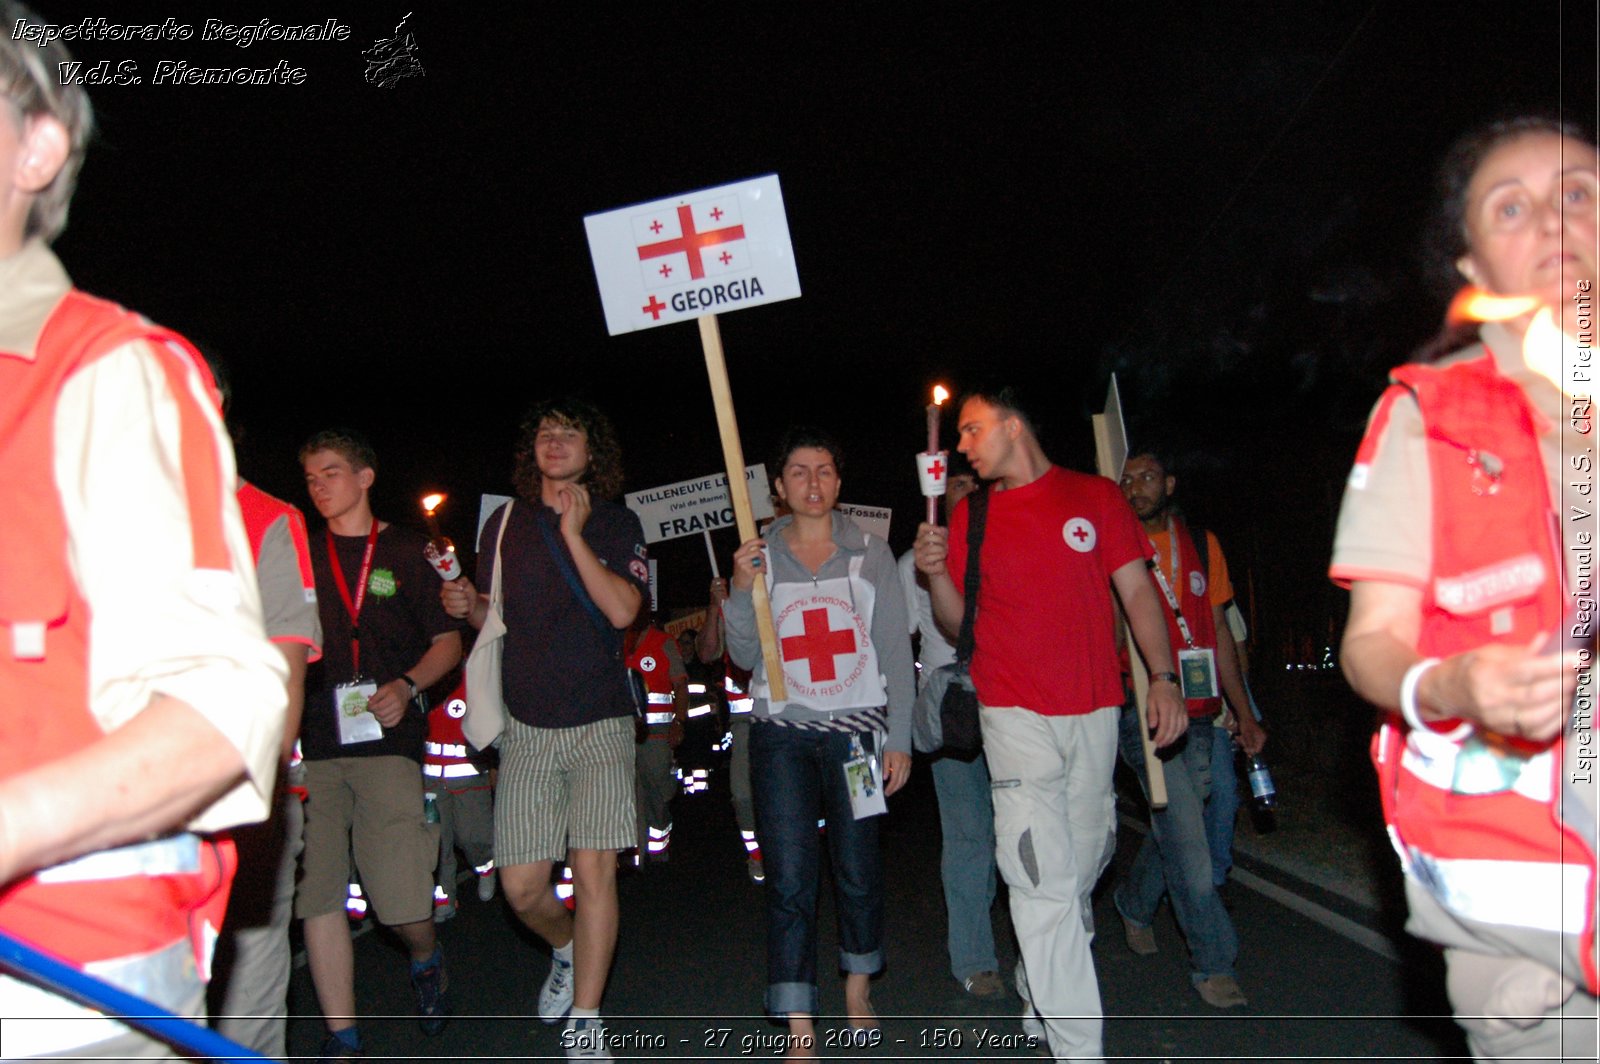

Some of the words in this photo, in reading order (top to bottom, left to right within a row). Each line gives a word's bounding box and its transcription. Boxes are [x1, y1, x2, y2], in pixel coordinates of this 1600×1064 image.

[671, 277, 764, 312] GEORGIA
[637, 480, 712, 505] VILLENEUVE
[670, 502, 686, 511] (Val
[699, 493, 727, 504] Marne)
[660, 507, 735, 538] FRANC
[783, 671, 817, 697] ORGIA
[820, 684, 843, 697] RED
[843, 653, 869, 688] CROSS
